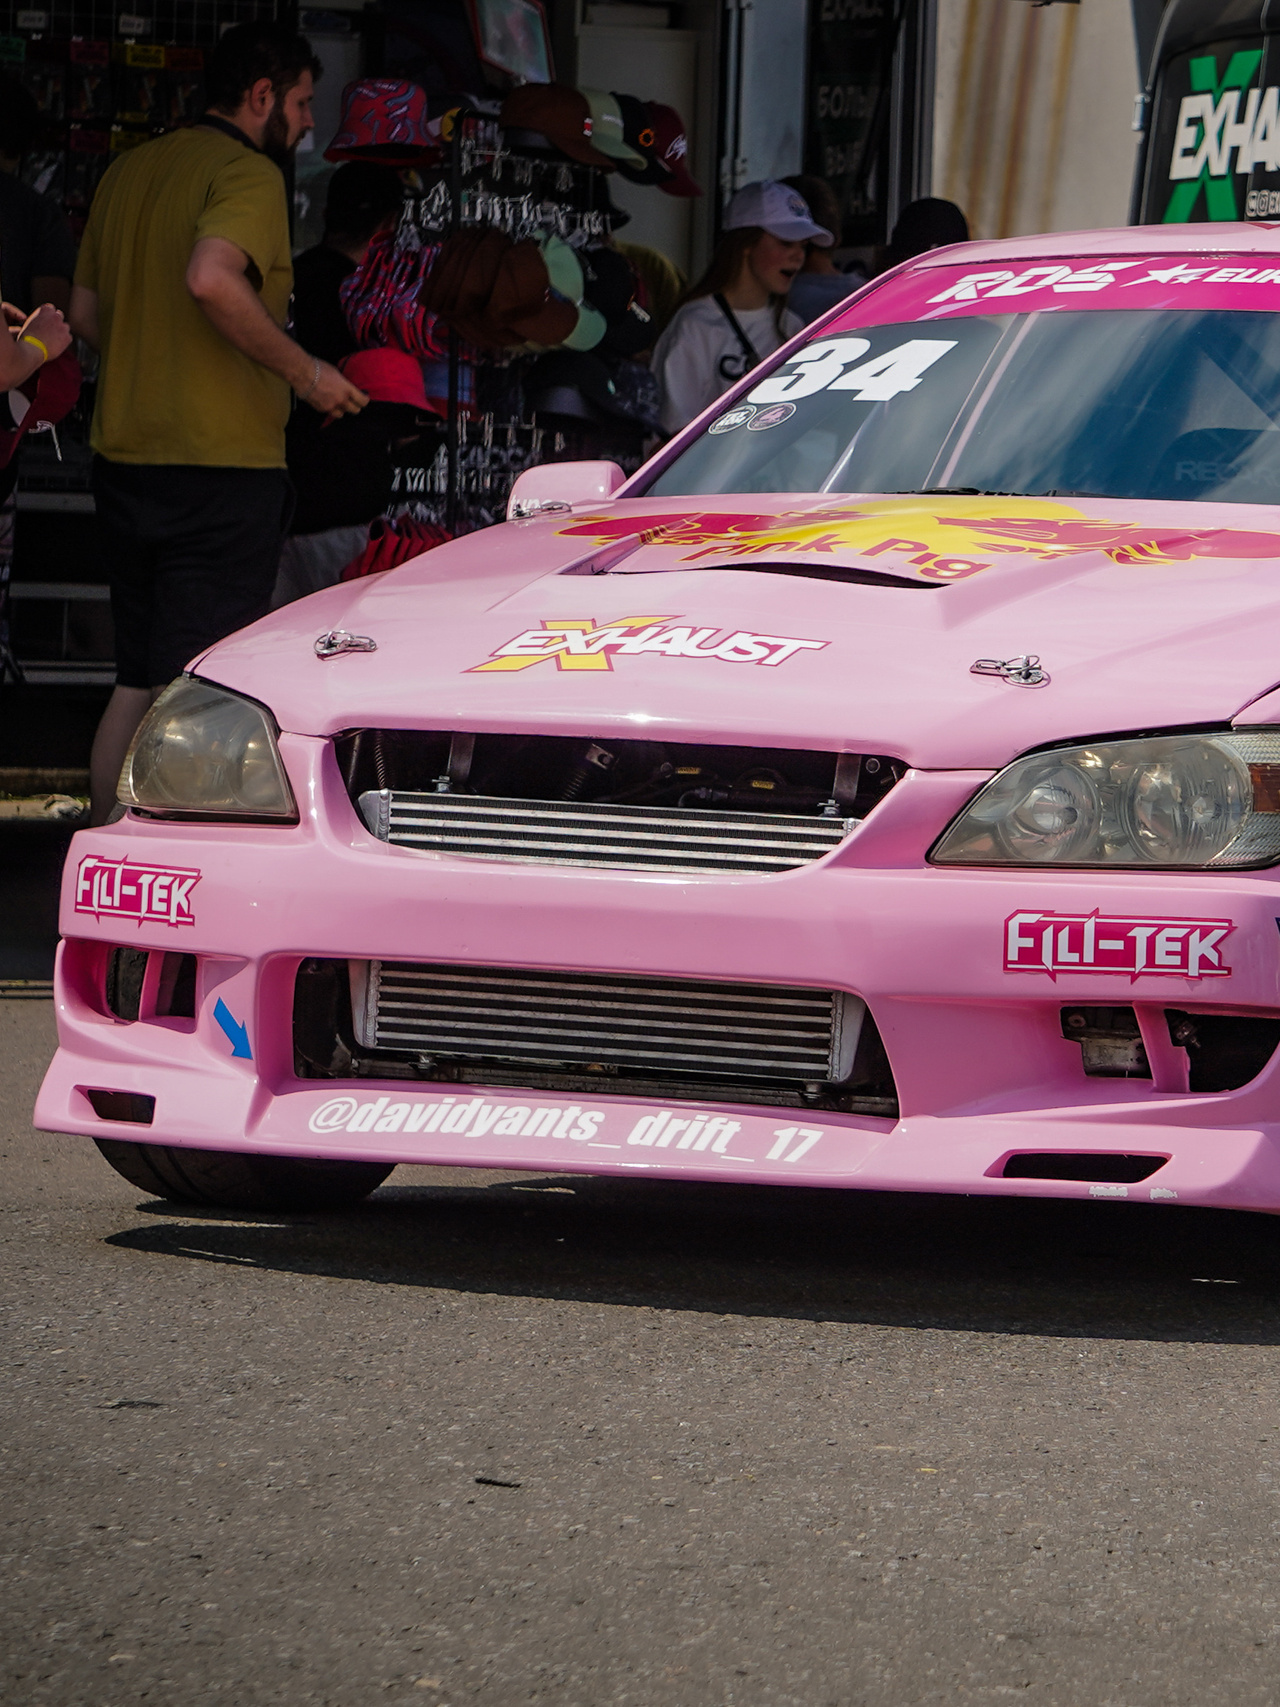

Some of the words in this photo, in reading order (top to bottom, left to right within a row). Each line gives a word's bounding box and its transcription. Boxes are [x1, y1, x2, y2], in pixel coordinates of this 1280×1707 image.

[925, 261, 1145, 303] RDS
[747, 337, 959, 404] 34
[490, 628, 831, 667] EXHAUST
[76, 857, 197, 923] FILI-TEK
[1007, 913, 1229, 977] FILI-TEK
